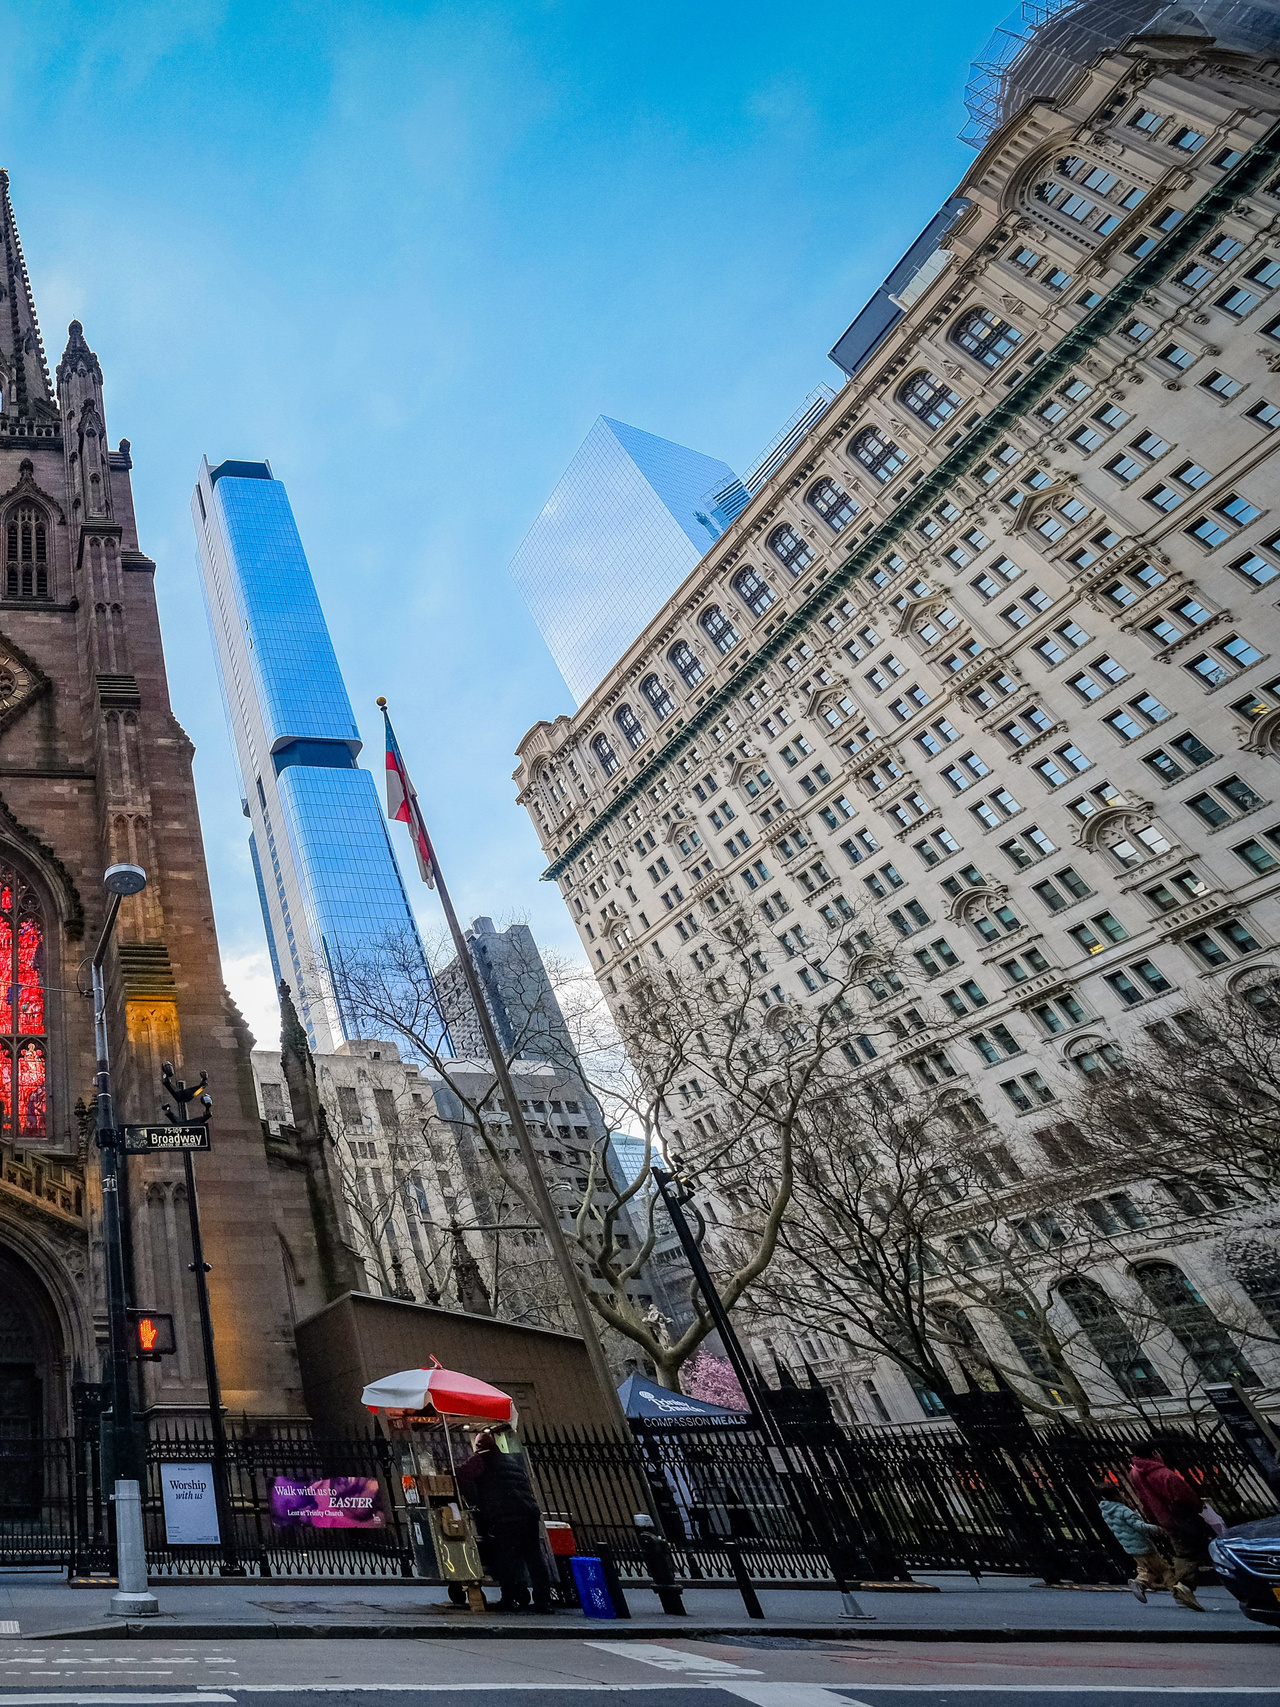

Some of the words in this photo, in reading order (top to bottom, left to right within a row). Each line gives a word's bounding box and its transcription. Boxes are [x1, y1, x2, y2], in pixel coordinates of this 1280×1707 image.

[151, 1133, 202, 1146] Broadway
[643, 1416, 712, 1428] COMPASSION
[711, 1415, 747, 1426] MEALS
[169, 1480, 207, 1492] Worship
[274, 1485, 297, 1496] Walk
[297, 1485, 317, 1496] with
[317, 1488, 328, 1496] us
[328, 1487, 338, 1497] to
[175, 1491, 193, 1500] with
[329, 1497, 374, 1509] EASTER
[305, 1509, 325, 1518] Trinity
[324, 1509, 345, 1517] Church
